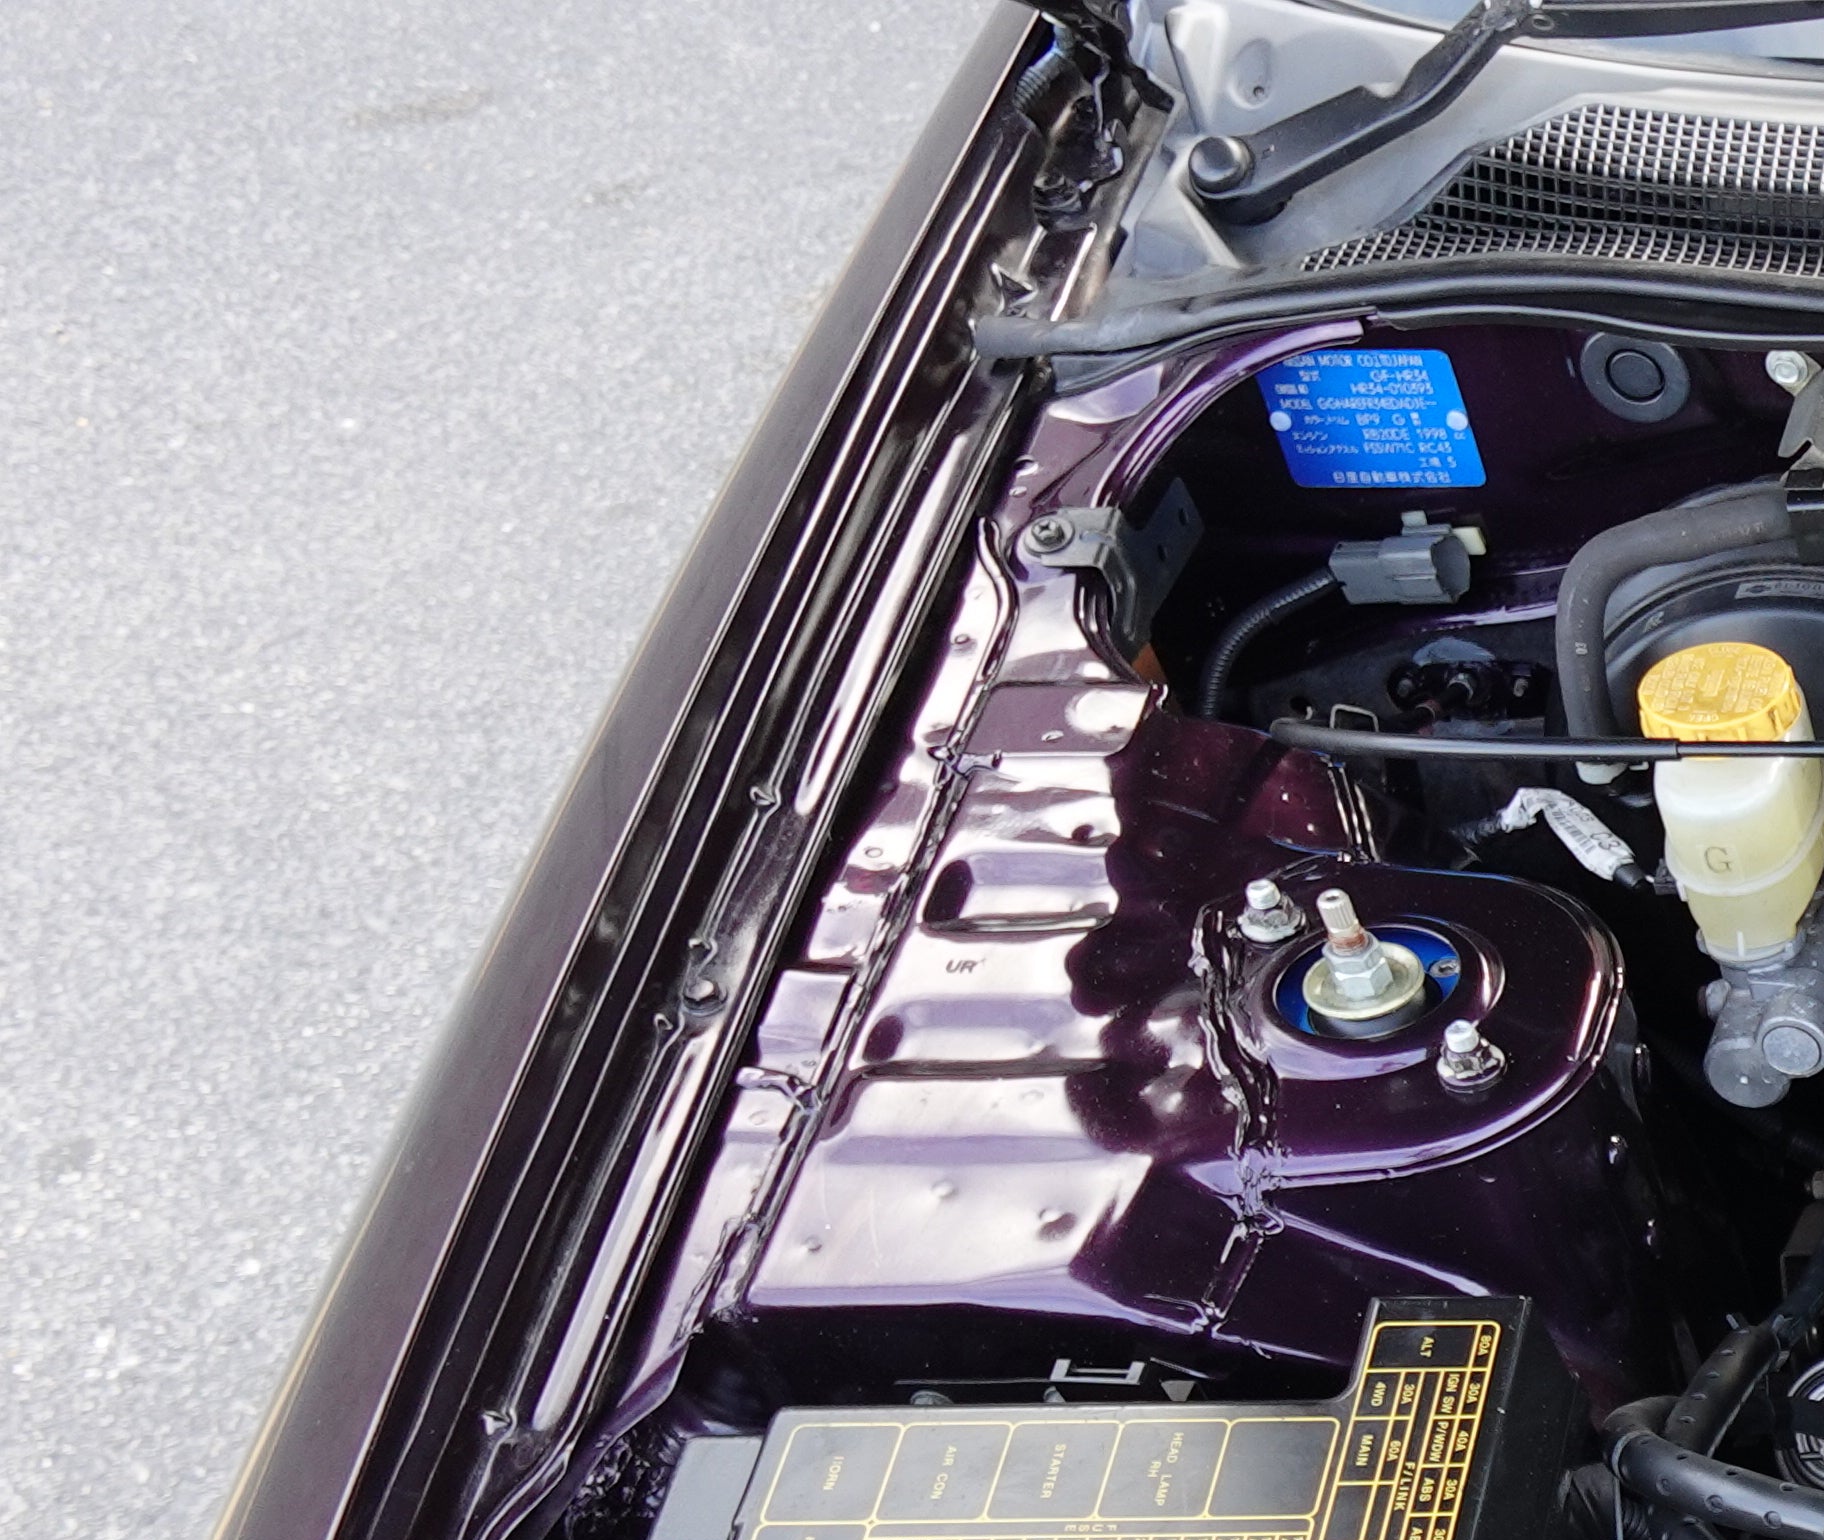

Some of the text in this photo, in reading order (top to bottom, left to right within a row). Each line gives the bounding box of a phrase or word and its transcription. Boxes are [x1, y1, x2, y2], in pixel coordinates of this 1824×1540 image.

[1420, 1336, 1434, 1358] ALT
[1371, 1381, 1387, 1407] 4WD
[1401, 1384, 1415, 1405] 30A
[1441, 1373, 1460, 1414] IGN SW
[1467, 1383, 1481, 1404] 30A
[1355, 1434, 1374, 1466] MAIN
[1455, 1430, 1469, 1452] 40A
[930, 1445, 957, 1500] AIR CON
[1040, 1443, 1067, 1499] STARTER
[1147, 1460, 1162, 1479] RH
[1156, 1432, 1184, 1507] HEAD LAMP
[1394, 1461, 1416, 1511] F/LINK
[1419, 1477, 1435, 1502] ABS
[1443, 1479, 1458, 1500] 30A
